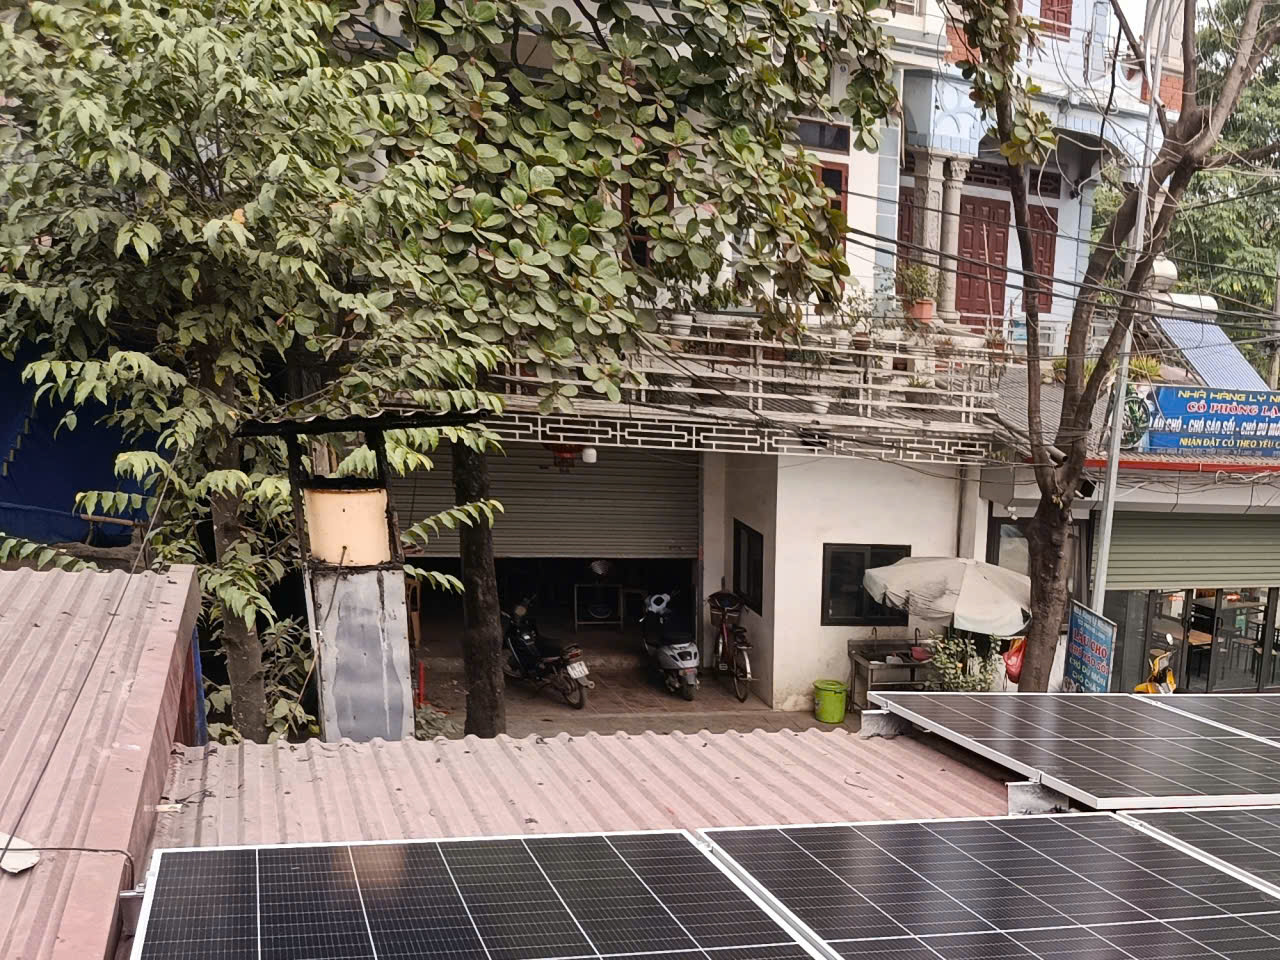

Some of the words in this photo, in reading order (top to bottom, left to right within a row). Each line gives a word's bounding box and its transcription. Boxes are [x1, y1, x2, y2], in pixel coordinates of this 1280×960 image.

[1209, 402, 1259, 415] PHÒNG
[1188, 417, 1204, 433] CHÓ
[1240, 419, 1257, 435] CHÓ
[1236, 439, 1257, 448] THEO
